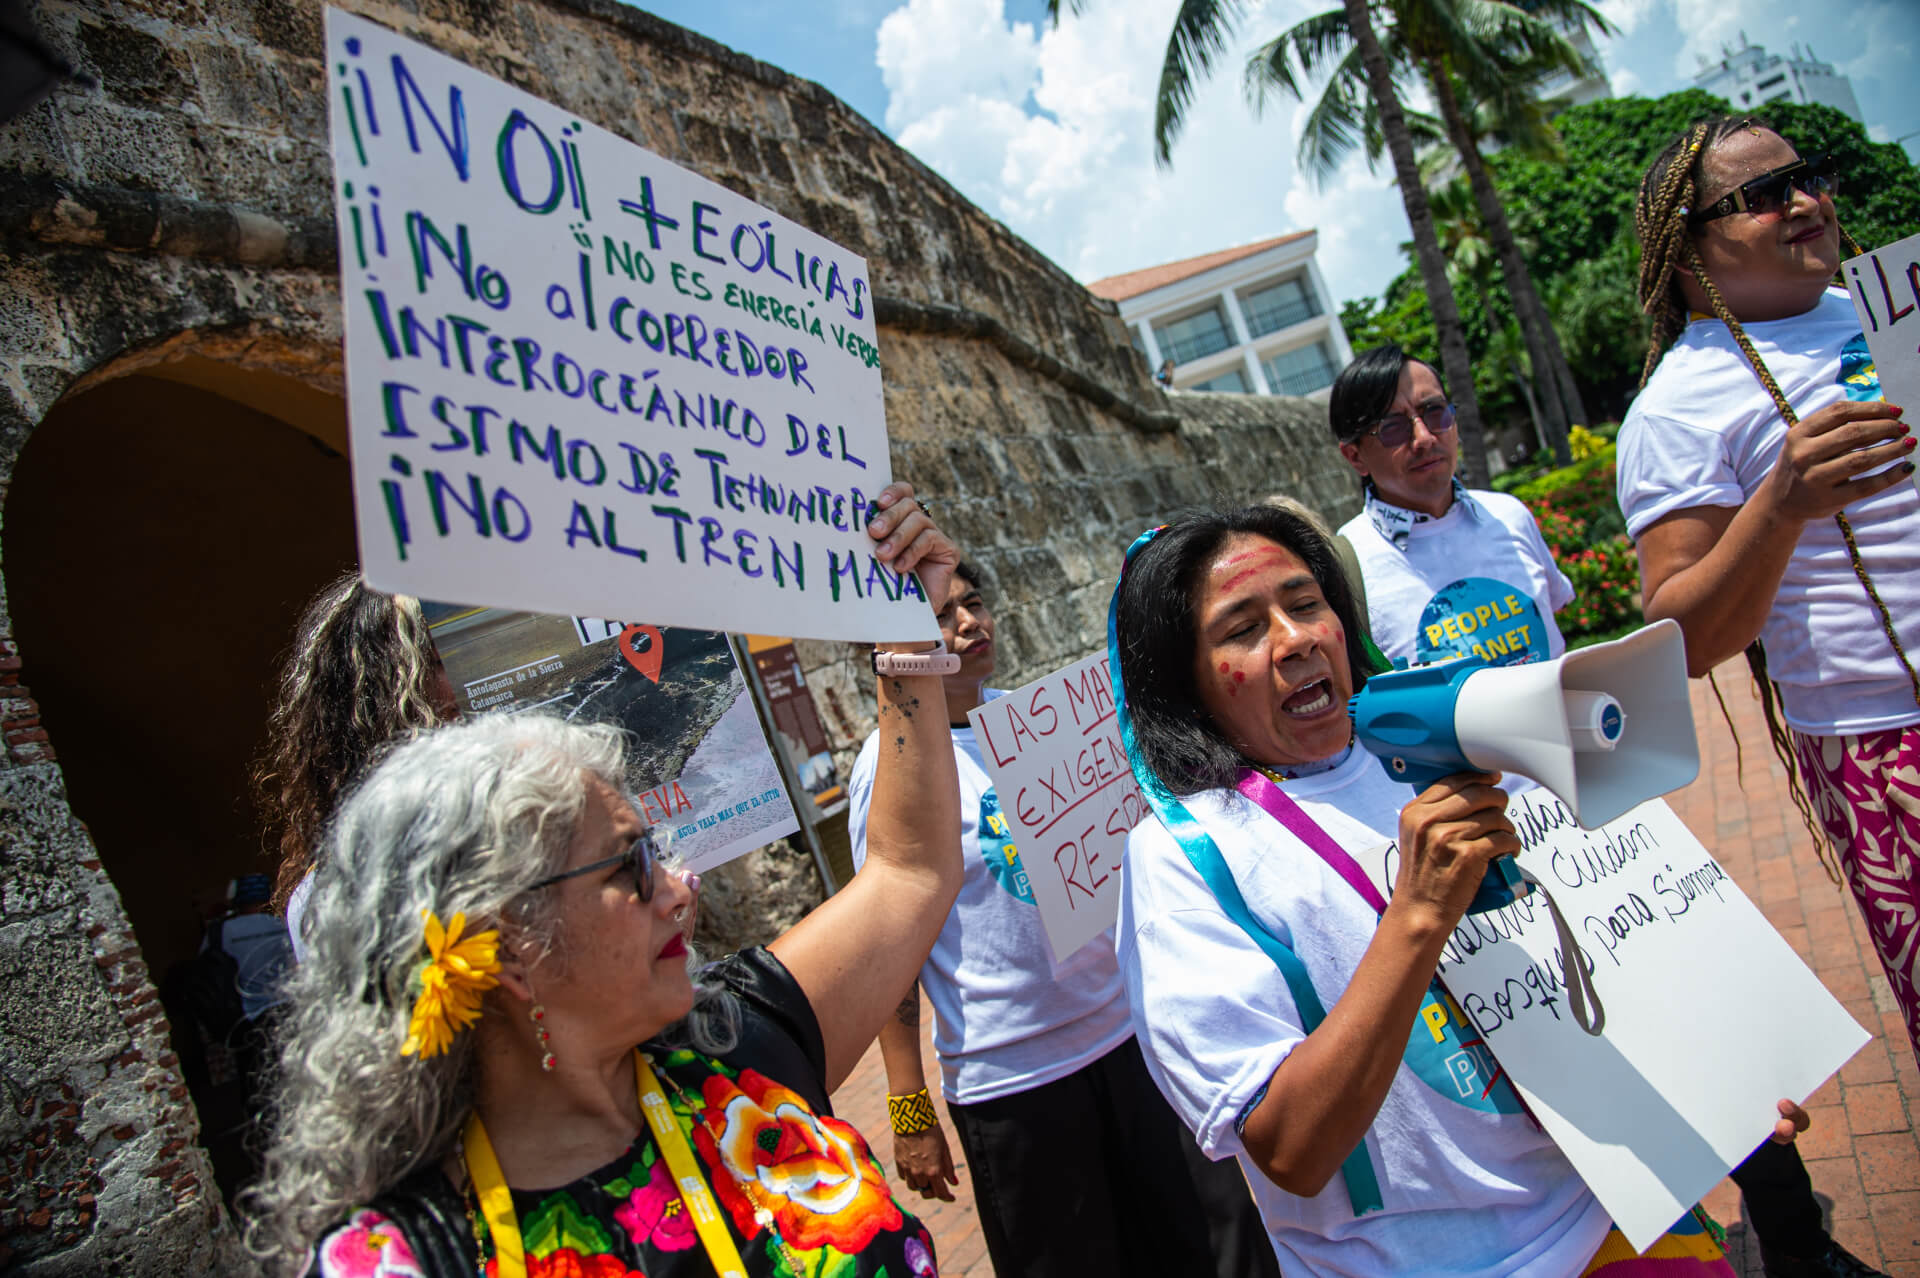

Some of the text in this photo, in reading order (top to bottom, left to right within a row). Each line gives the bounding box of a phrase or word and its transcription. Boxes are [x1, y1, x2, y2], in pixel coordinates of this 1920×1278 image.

[671, 262, 713, 301] ES
[724, 282, 826, 345] ENERGÍA
[831, 323, 880, 369] VERDE
[609, 296, 815, 395] CORREDOR
[617, 441, 681, 498] DE
[785, 413, 866, 470] DEL
[563, 499, 647, 563] AL
[651, 504, 804, 592] TREN
[827, 549, 927, 602] MAYA
[1424, 594, 1524, 648] PEOPLE
[466, 660, 564, 699] Antofagasta de la Sierra
[470, 690, 515, 711] Catamarca
[977, 686, 1058, 768] LAS
[697, 814, 717, 830] VALE
[735, 801, 750, 815] QUE
[750, 797, 761, 808] EL
